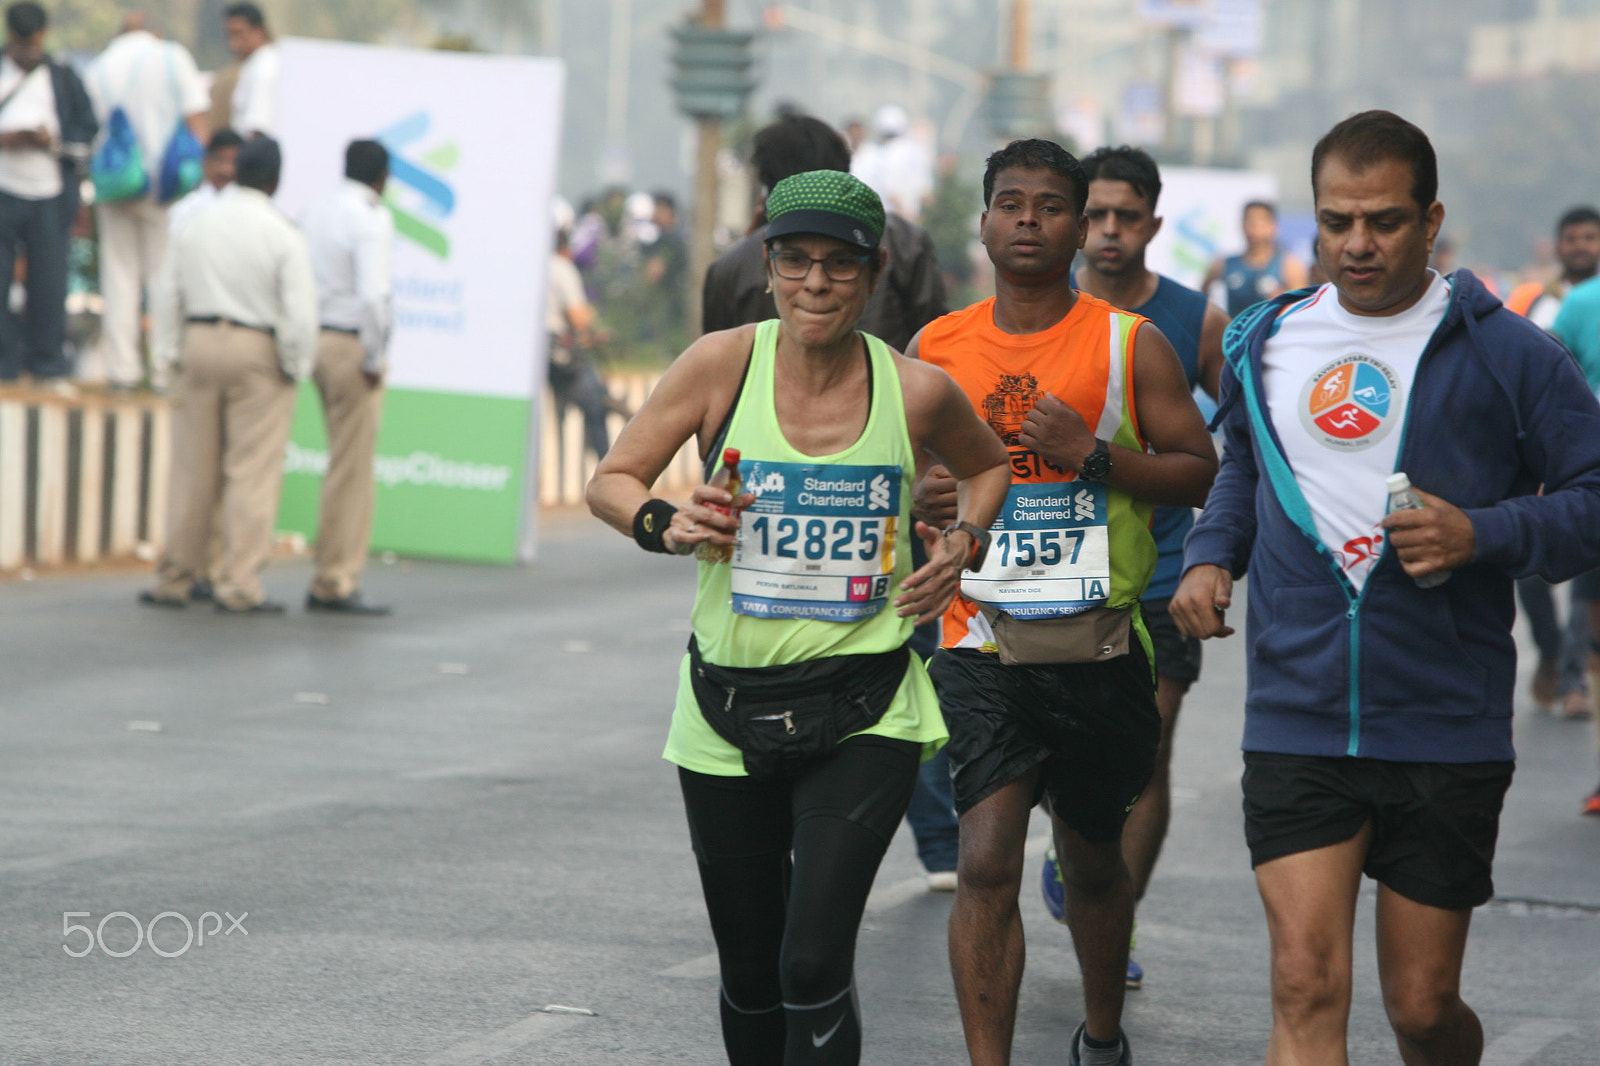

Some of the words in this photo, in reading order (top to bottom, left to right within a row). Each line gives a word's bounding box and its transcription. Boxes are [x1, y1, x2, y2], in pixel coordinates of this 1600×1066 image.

[804, 478, 866, 492] Standard
[798, 493, 865, 507] Chartered
[1016, 496, 1070, 508] Standard
[1013, 509, 1071, 521] Chartered
[752, 516, 880, 561] 12825
[996, 529, 1085, 567] 1557
[853, 583, 868, 596] W
[874, 577, 888, 598] B
[1088, 580, 1106, 598] A
[742, 601, 769, 613] TATA
[771, 603, 842, 617] CONSULTANCY
